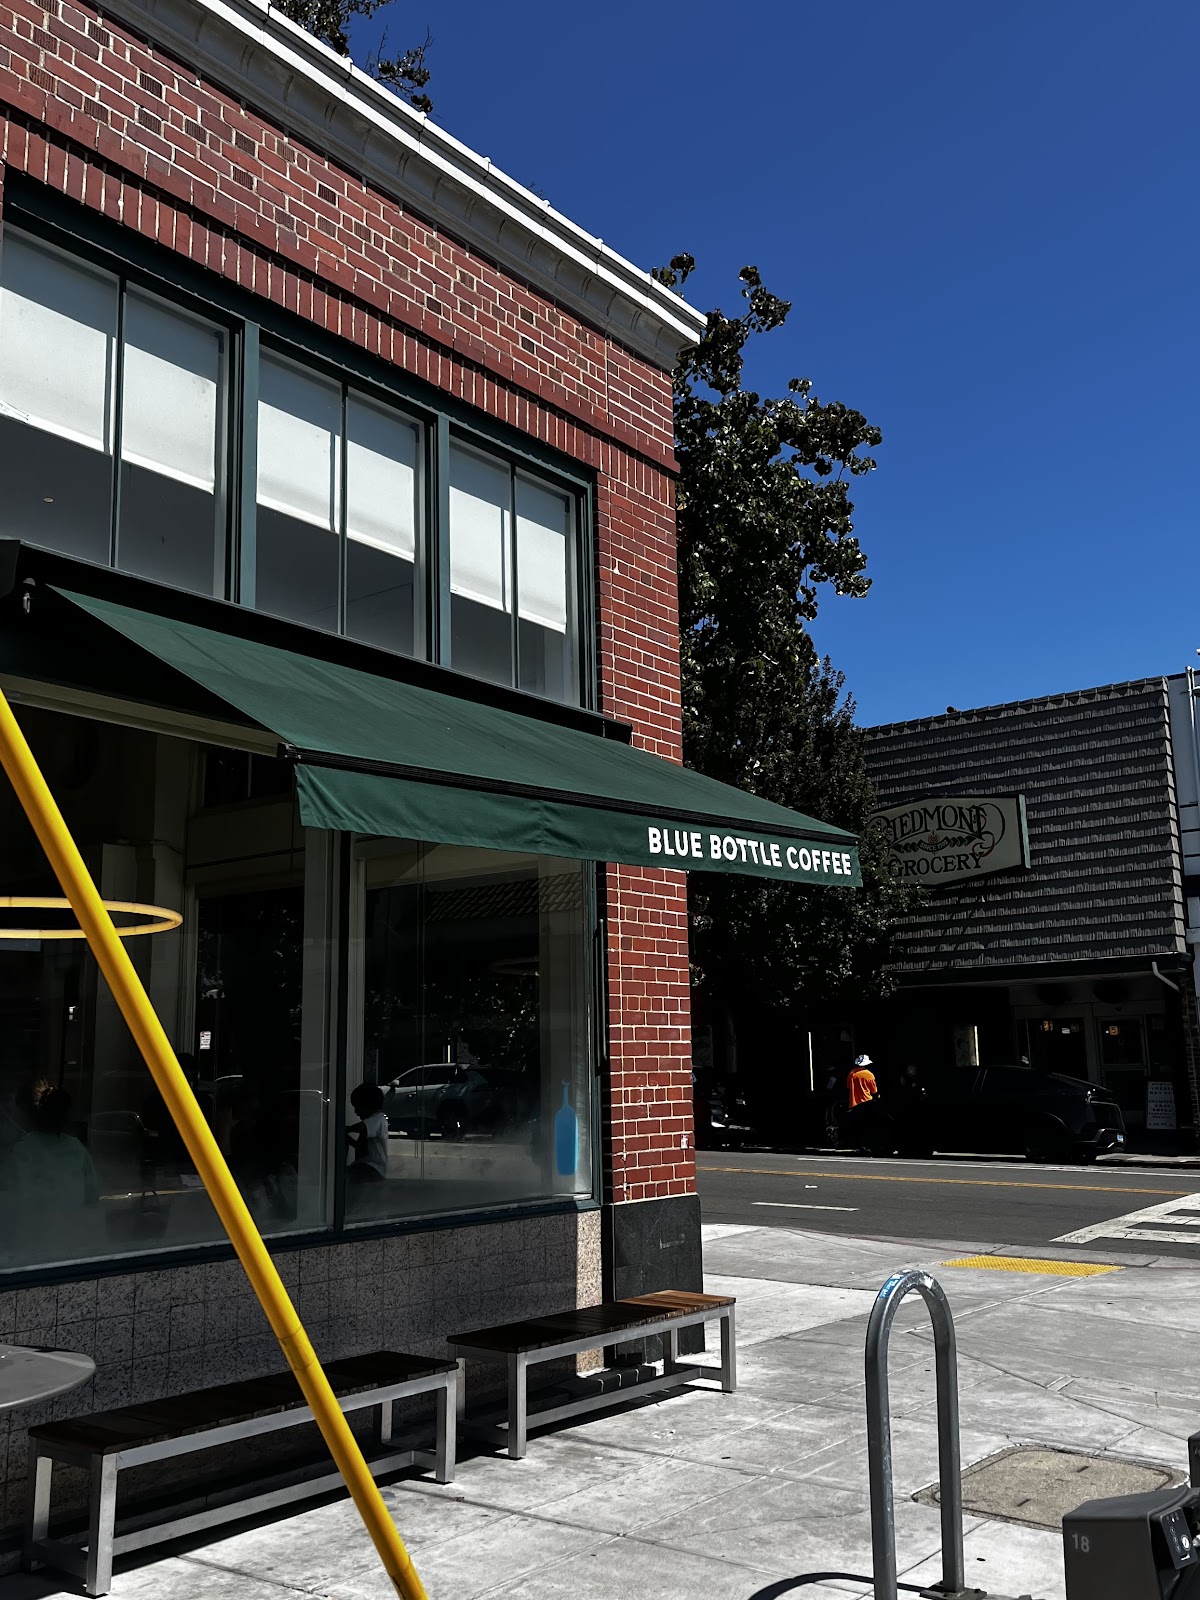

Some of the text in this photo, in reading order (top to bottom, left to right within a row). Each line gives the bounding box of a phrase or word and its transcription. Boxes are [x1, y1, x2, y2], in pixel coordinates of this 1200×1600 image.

[648, 827, 852, 876] BLUE BOTTLE COFFEE
[919, 842, 937, 851] SINCE
[884, 850, 985, 879] GROCERY
[1071, 1533, 1090, 1553] 18
